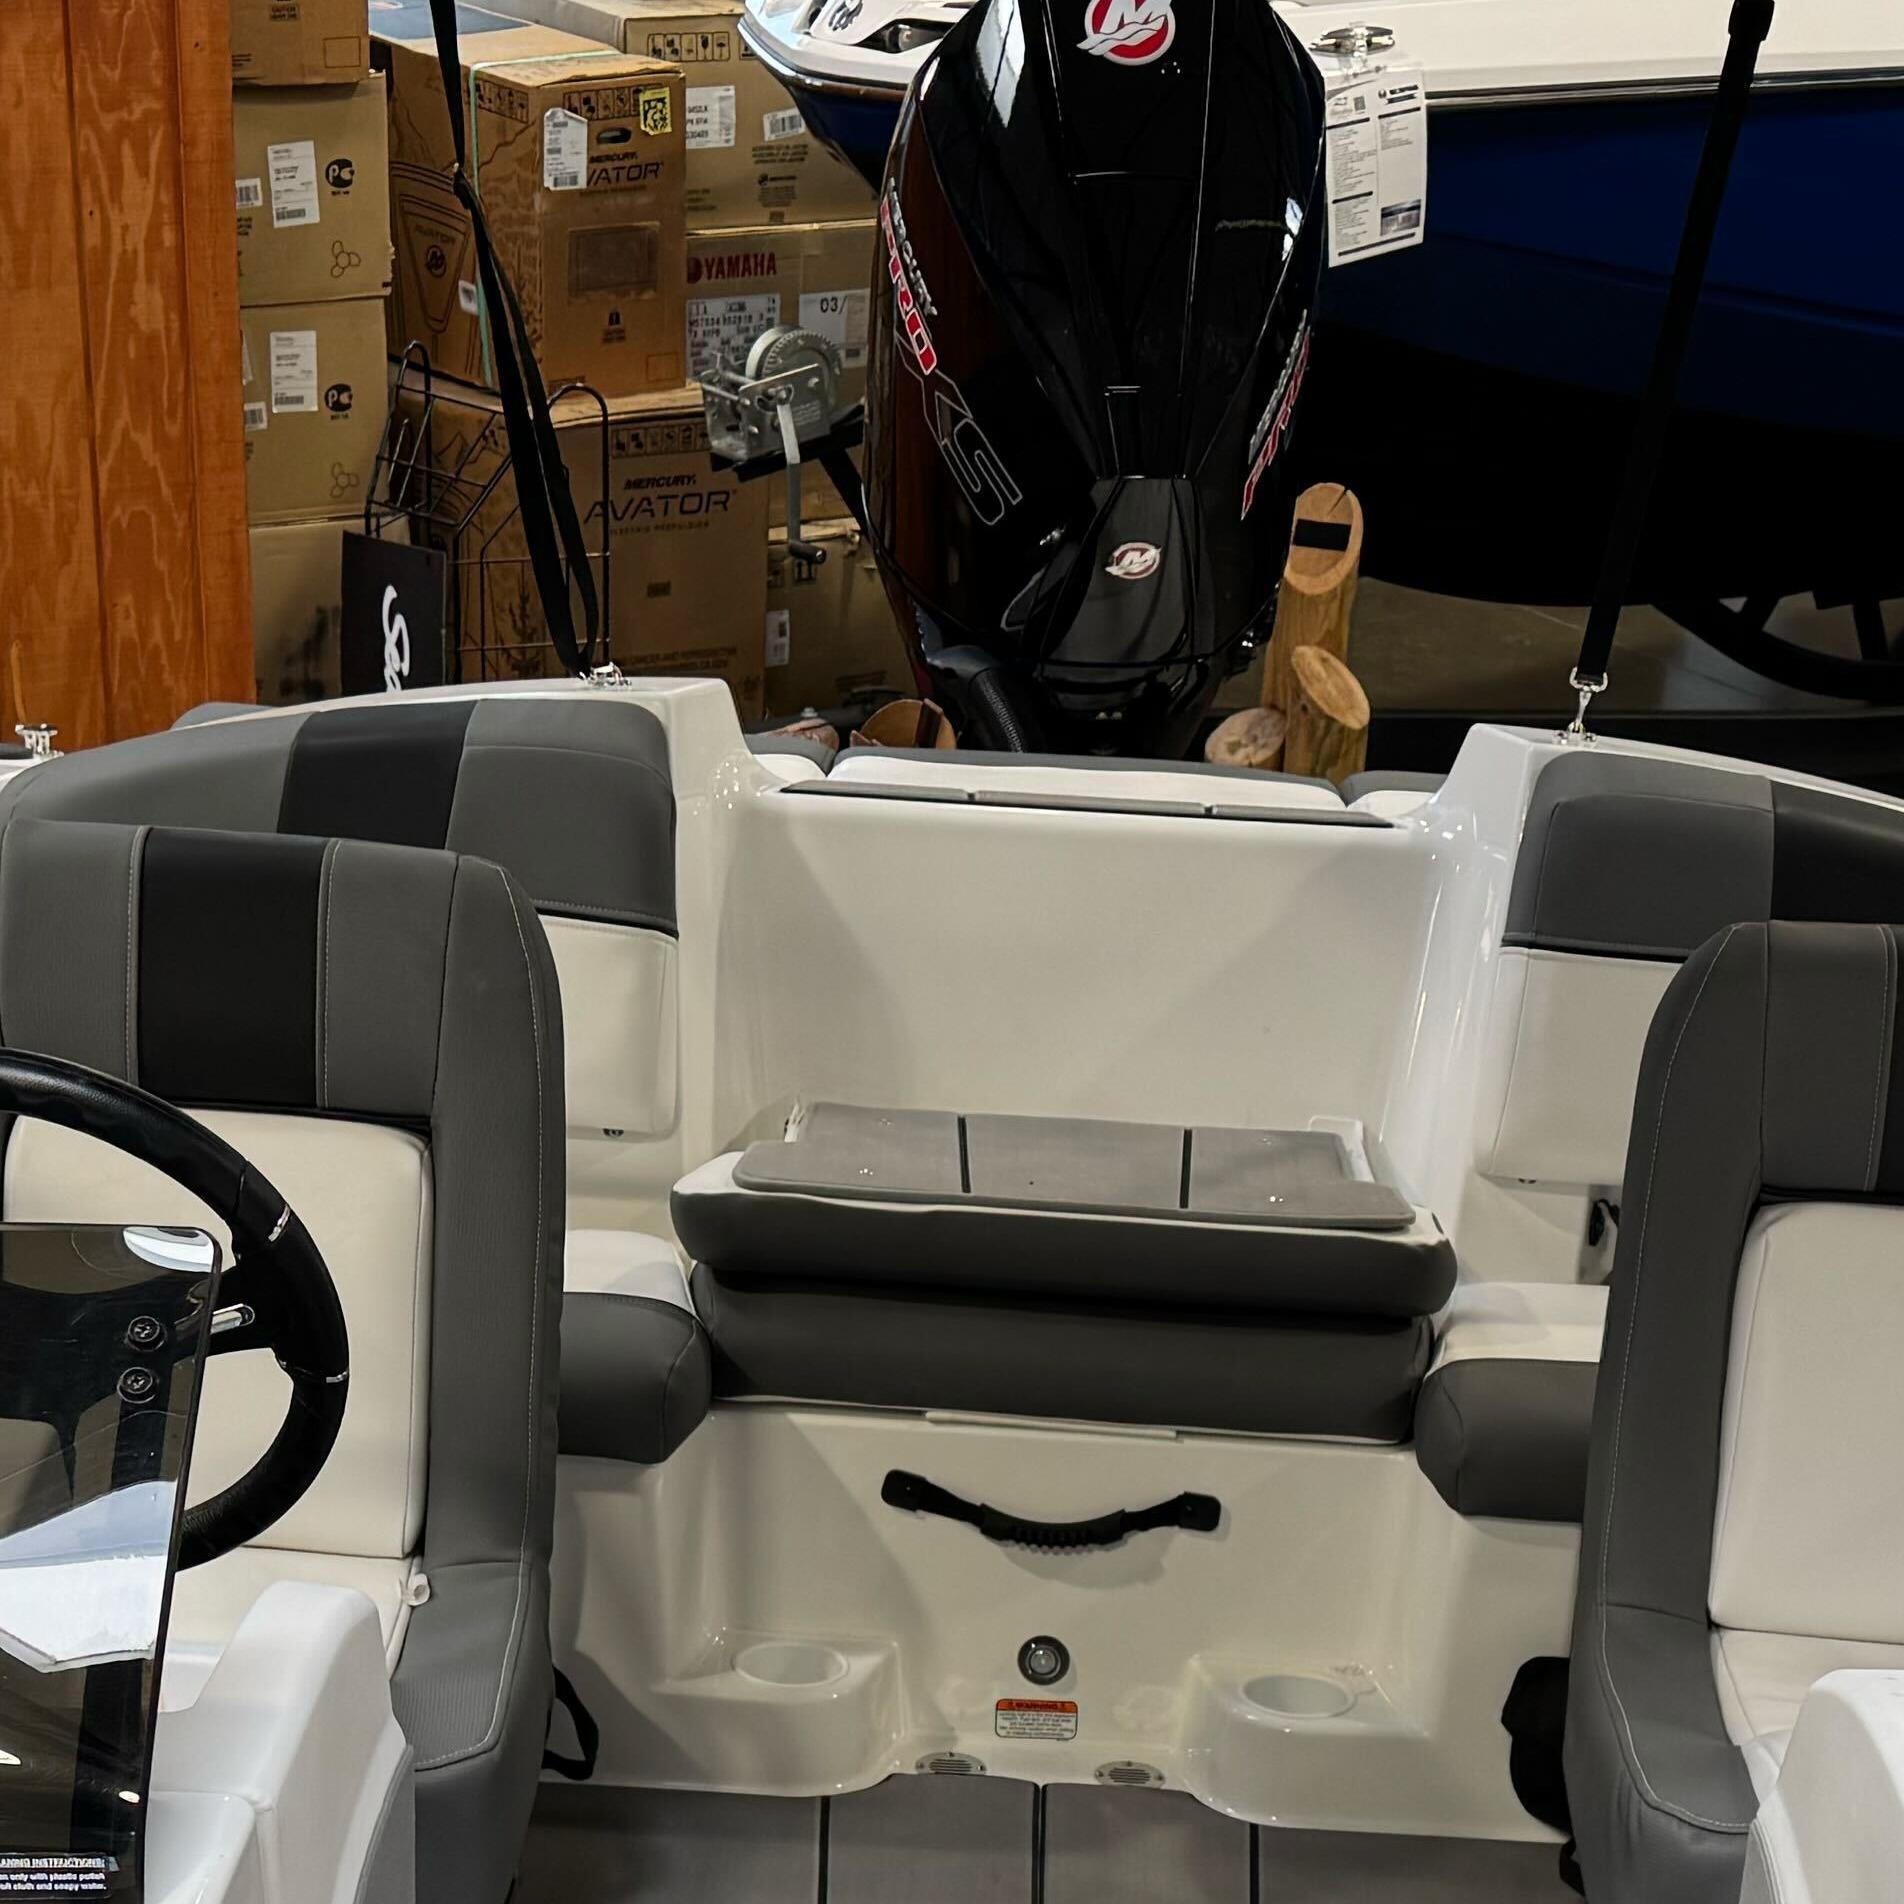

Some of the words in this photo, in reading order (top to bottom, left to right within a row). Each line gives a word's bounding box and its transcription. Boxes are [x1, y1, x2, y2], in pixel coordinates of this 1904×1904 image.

[586, 161, 665, 187] VATOR
[704, 252, 777, 281] YAMAHA
[880, 196, 937, 375] PRO
[624, 474, 696, 490] MERCURY
[584, 490, 730, 524] AVATOR
